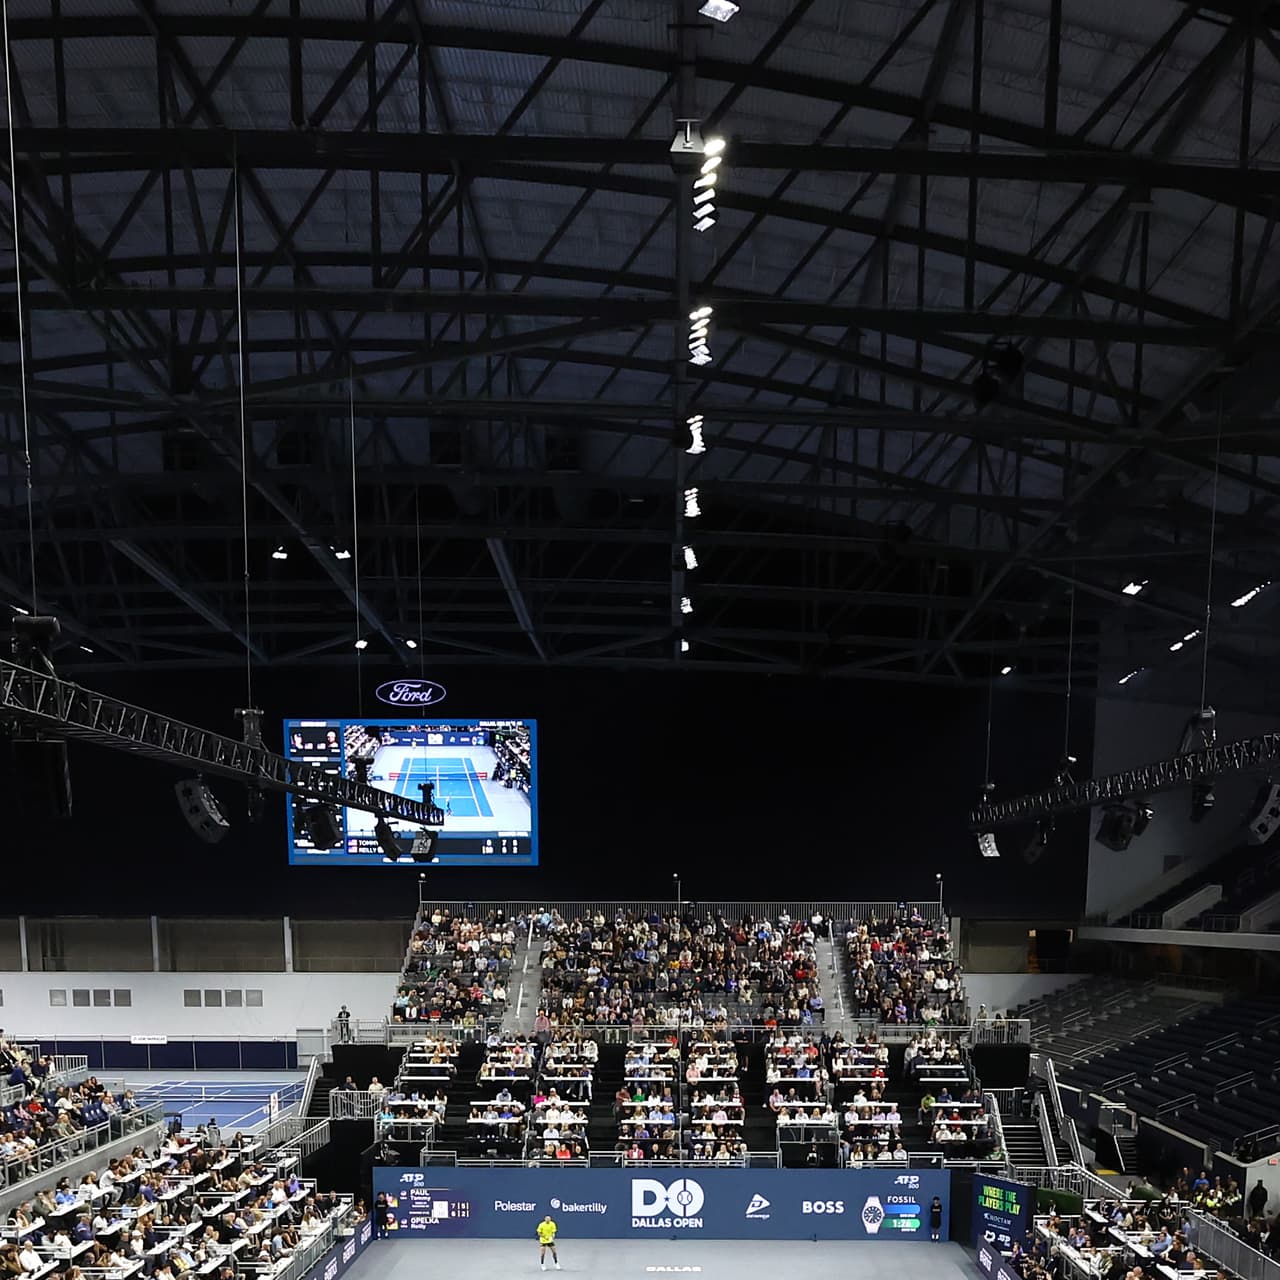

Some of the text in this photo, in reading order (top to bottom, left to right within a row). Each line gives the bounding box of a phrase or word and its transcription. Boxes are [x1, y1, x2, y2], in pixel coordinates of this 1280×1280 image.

[389, 682, 433, 702] Ford
[400, 1173, 424, 1182] ATP
[894, 1175, 920, 1185] ATP
[983, 1184, 1017, 1203] WHERE THE
[494, 1200, 537, 1211] Polestar
[562, 1202, 607, 1215] bakertilly
[802, 1201, 845, 1214] BOSS
[978, 1195, 1021, 1215] PLAYERS PLAY
[632, 1218, 703, 1228] DALLAS OPEN
